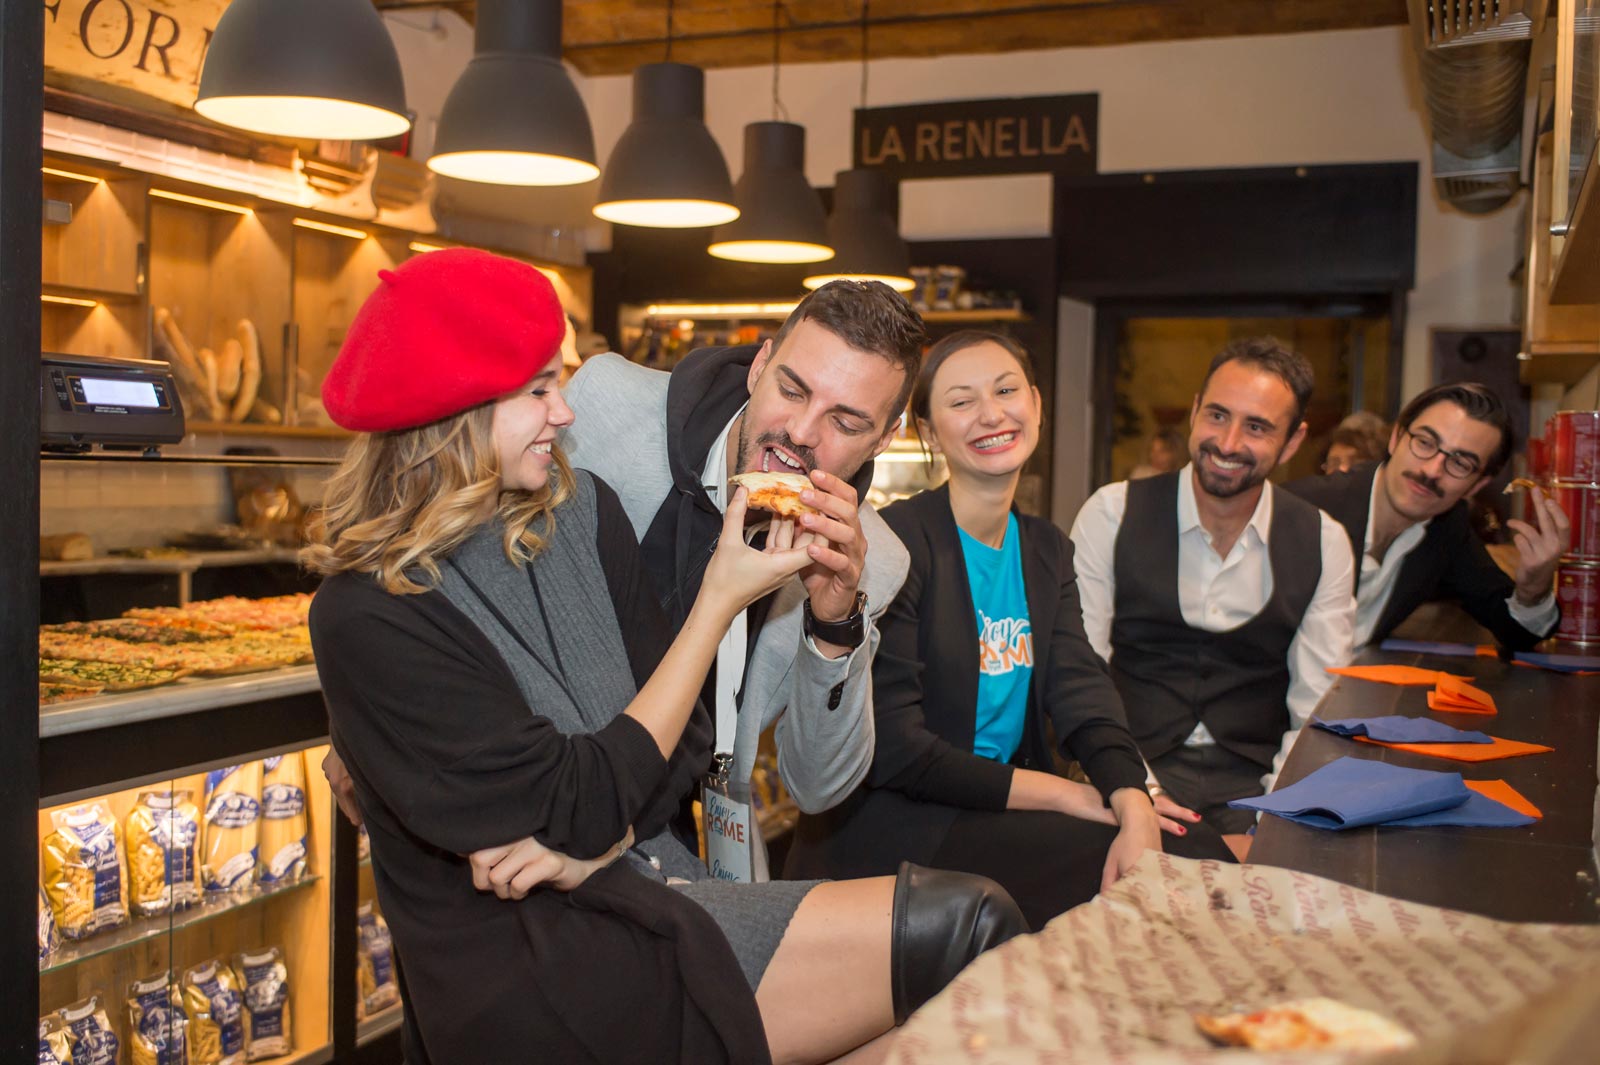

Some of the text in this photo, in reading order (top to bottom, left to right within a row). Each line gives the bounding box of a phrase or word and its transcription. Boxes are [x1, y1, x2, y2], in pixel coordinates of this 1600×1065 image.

[45, 0, 213, 86] OR
[861, 114, 1090, 165] LA RENELLA
[708, 812, 745, 844] ROME
